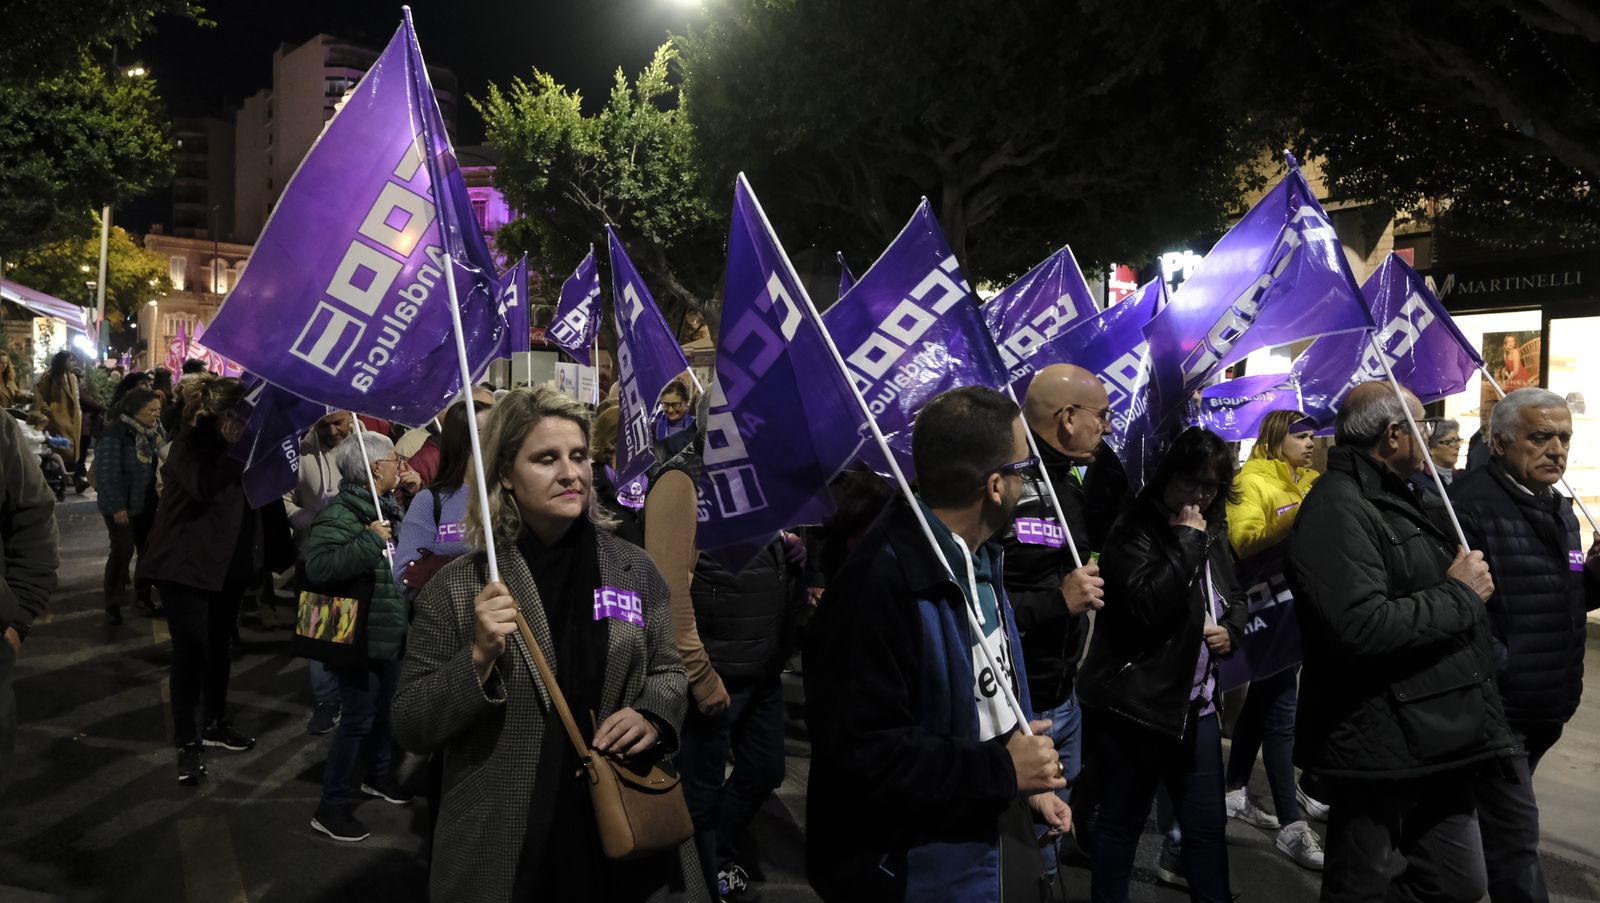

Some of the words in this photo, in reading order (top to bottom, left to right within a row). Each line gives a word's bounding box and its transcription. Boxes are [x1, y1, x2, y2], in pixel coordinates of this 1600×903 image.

[1162, 250, 1203, 282] Ph
[1457, 270, 1584, 296] MARTINELLI
[1017, 522, 1063, 539] CCOO
[593, 590, 643, 615] CCOO
